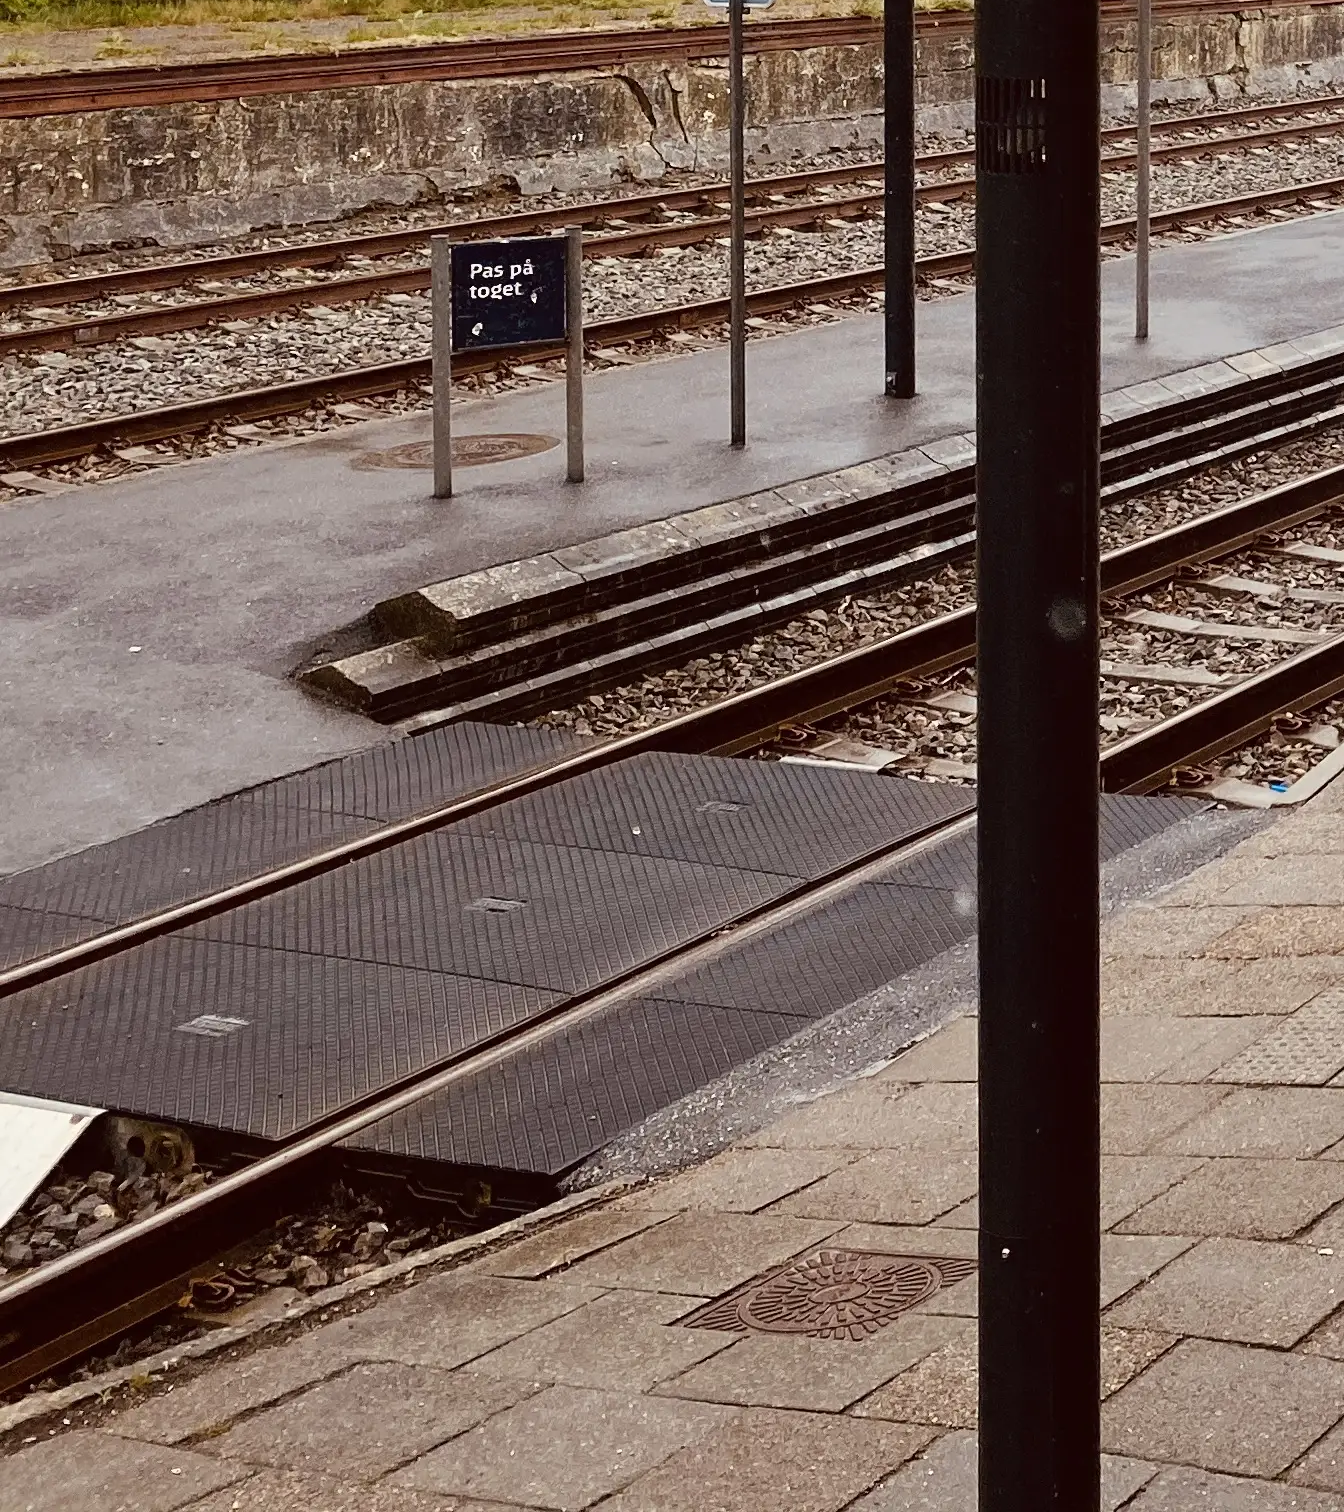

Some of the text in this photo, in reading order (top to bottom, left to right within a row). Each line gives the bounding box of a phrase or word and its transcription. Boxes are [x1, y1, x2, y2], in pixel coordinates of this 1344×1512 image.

[470, 258, 534, 280] Pas på
[469, 281, 524, 300] toget
